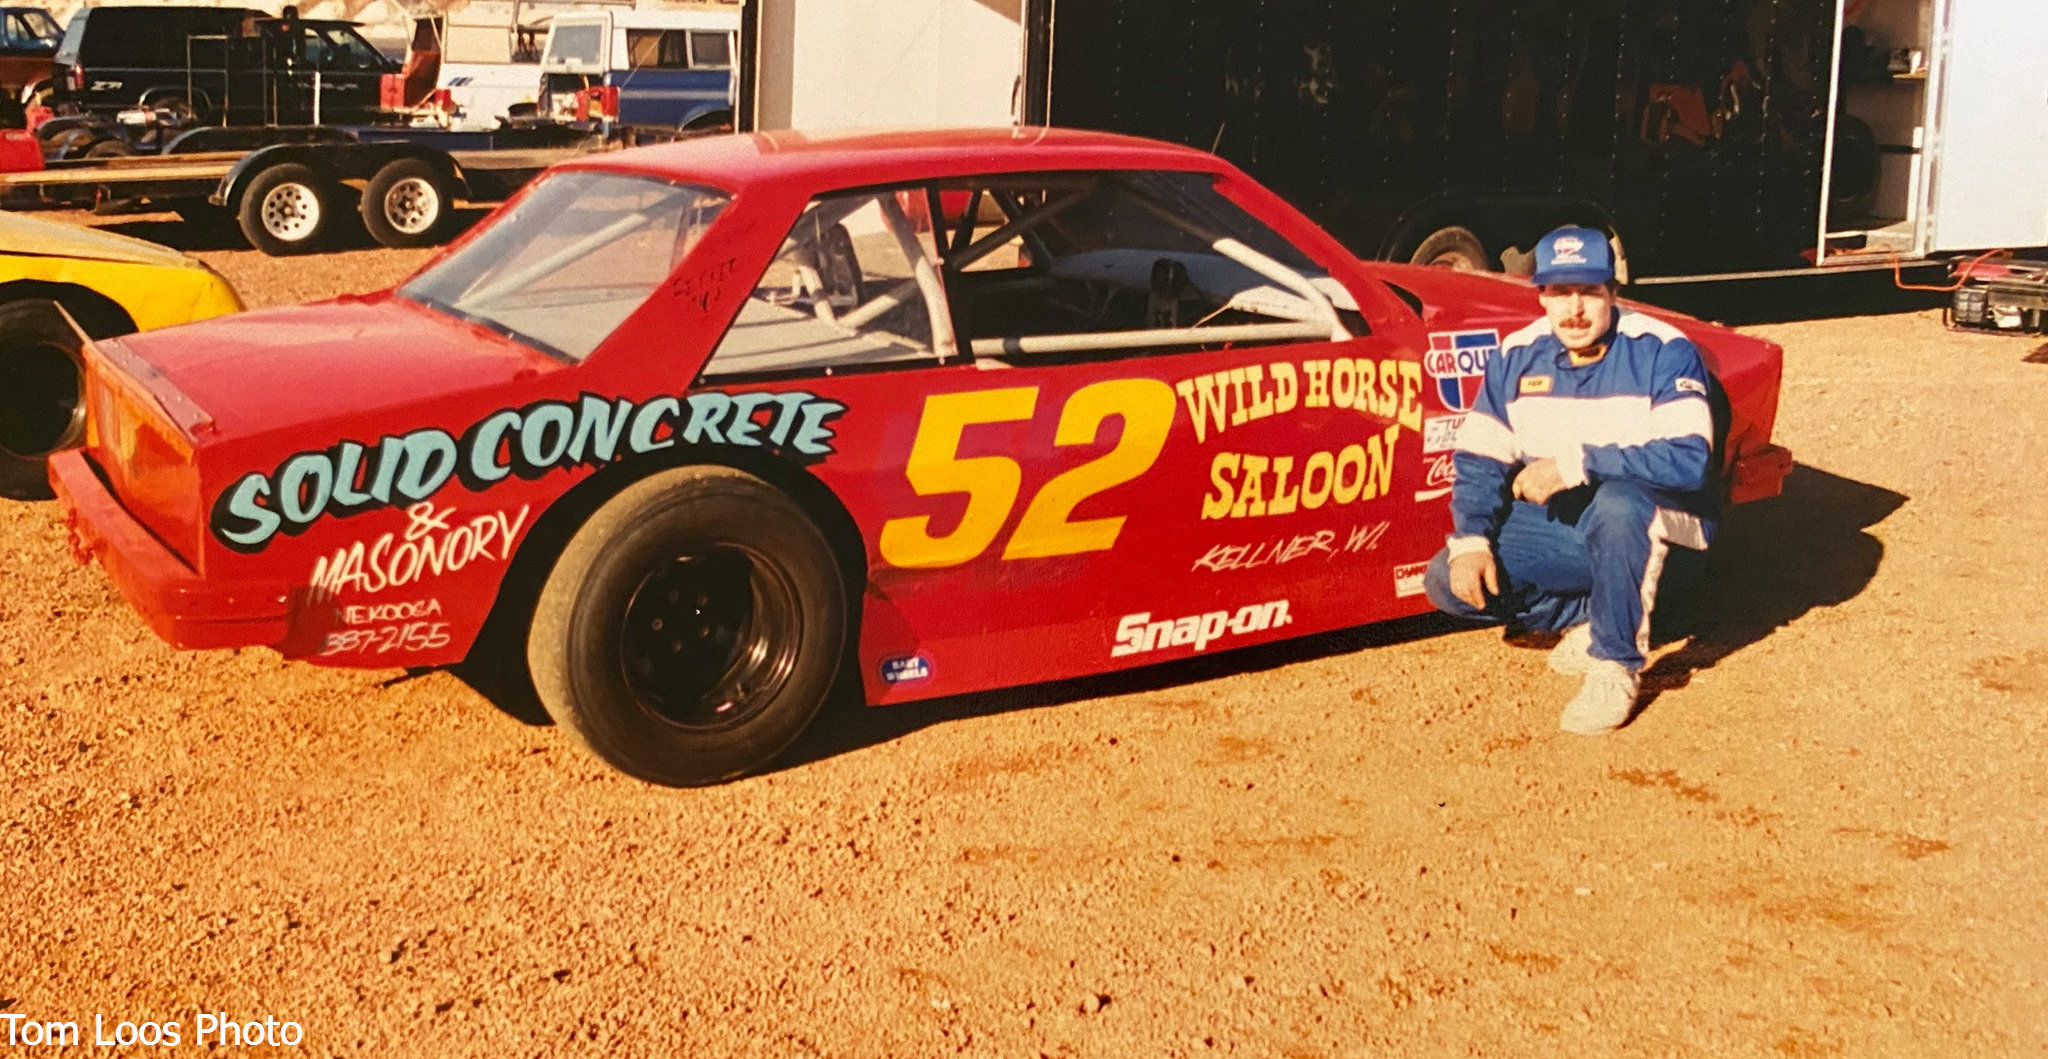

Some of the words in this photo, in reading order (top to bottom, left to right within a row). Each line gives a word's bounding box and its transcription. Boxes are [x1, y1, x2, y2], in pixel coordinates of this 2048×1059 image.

[1176, 372, 1299, 443] WILD
[1303, 358, 1422, 432] HORSE
[1426, 350, 1489, 375] CARQU
[219, 428, 459, 546] SOLID
[470, 392, 850, 482] CONCRETE
[878, 377, 1177, 569] 52
[1200, 424, 1400, 520] SALOON
[305, 504, 530, 606] MASONORY
[404, 501, 457, 542] &
[1191, 529, 1339, 573] KELLNER,
[319, 621, 451, 657] 387-2155
